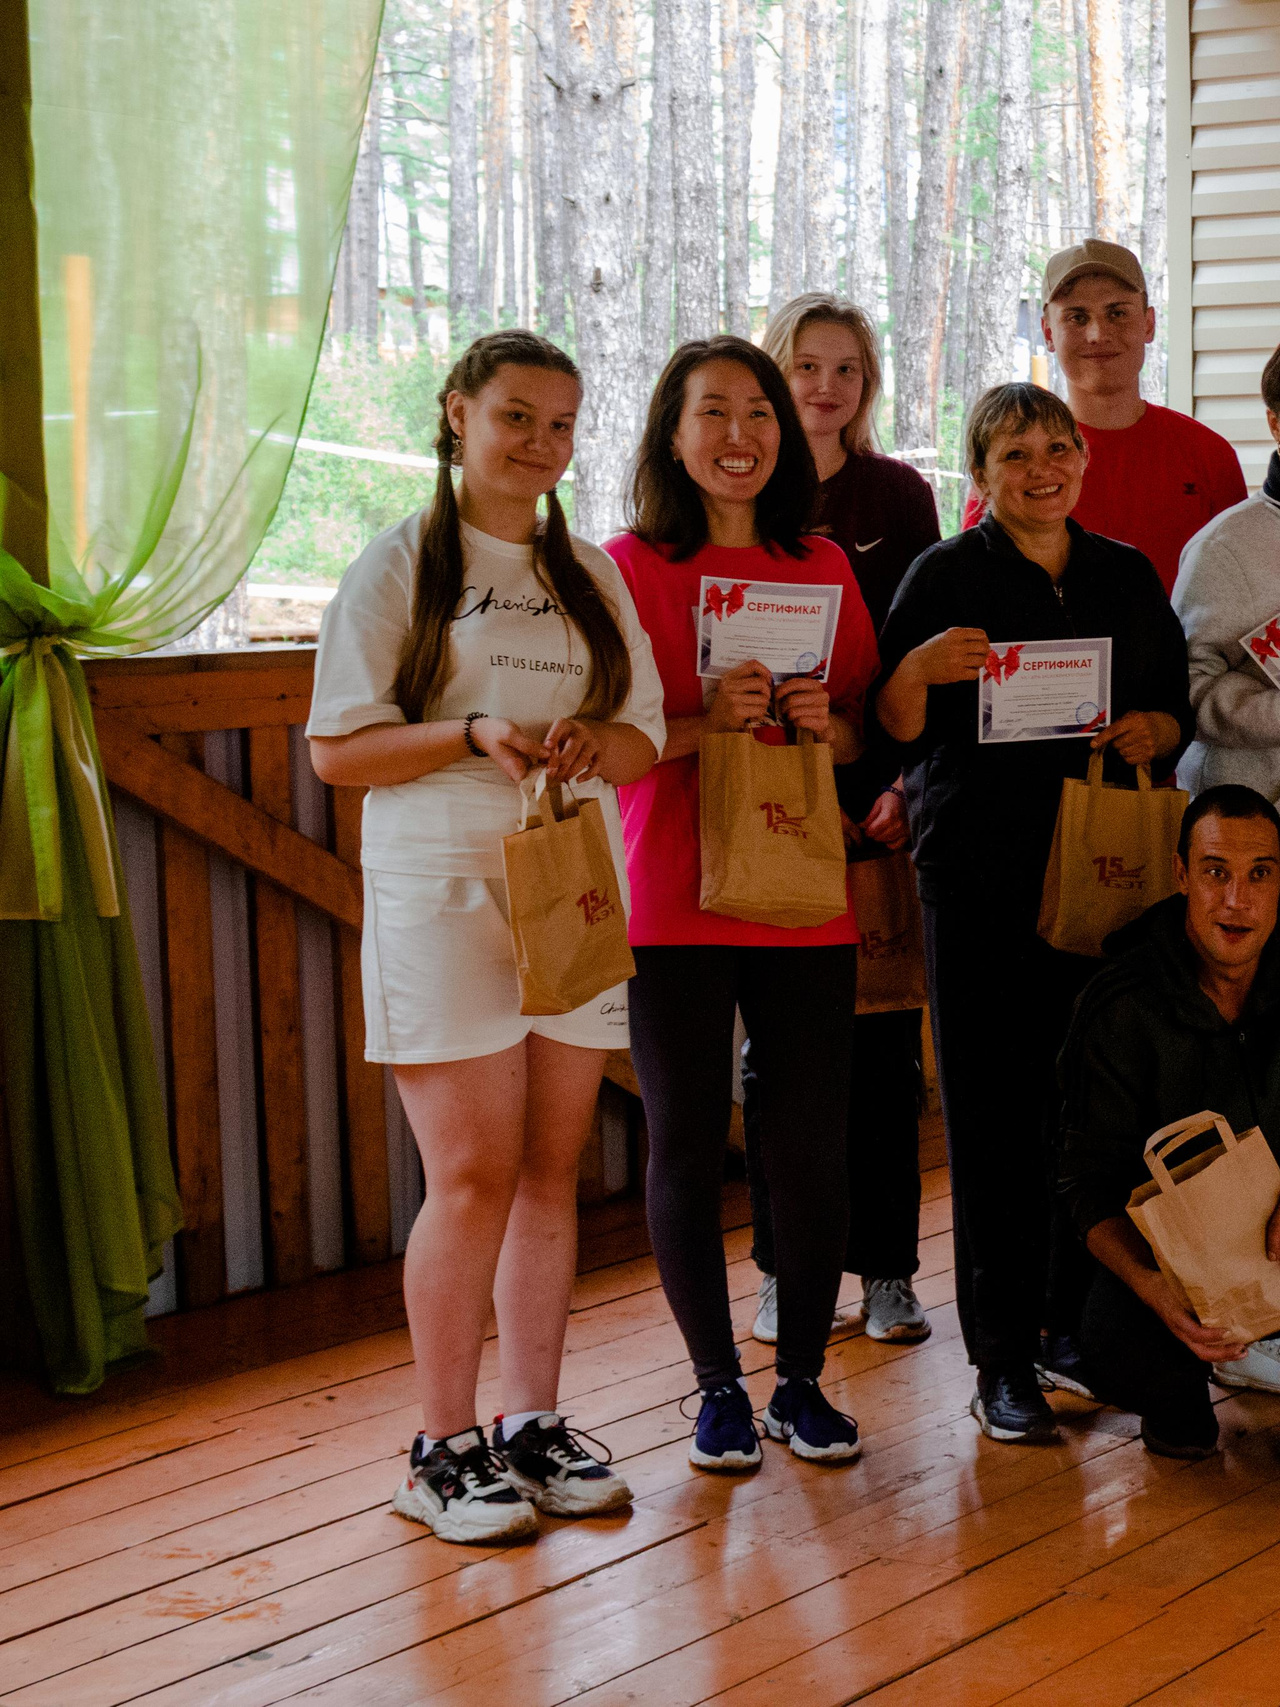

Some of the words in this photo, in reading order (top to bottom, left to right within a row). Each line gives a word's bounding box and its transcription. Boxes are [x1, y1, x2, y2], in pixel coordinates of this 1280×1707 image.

[450, 586, 570, 620] Cherish
[747, 601, 822, 615] СЕРТИФИКАТ
[490, 655, 510, 667] LET
[512, 657, 527, 669] US
[529, 660, 565, 674] LEARN
[568, 664, 584, 676] TO
[1023, 658, 1093, 672] СЕРТИФИКАТ
[759, 801, 787, 829] 15
[1092, 856, 1124, 882] 15
[576, 888, 600, 925] 15
